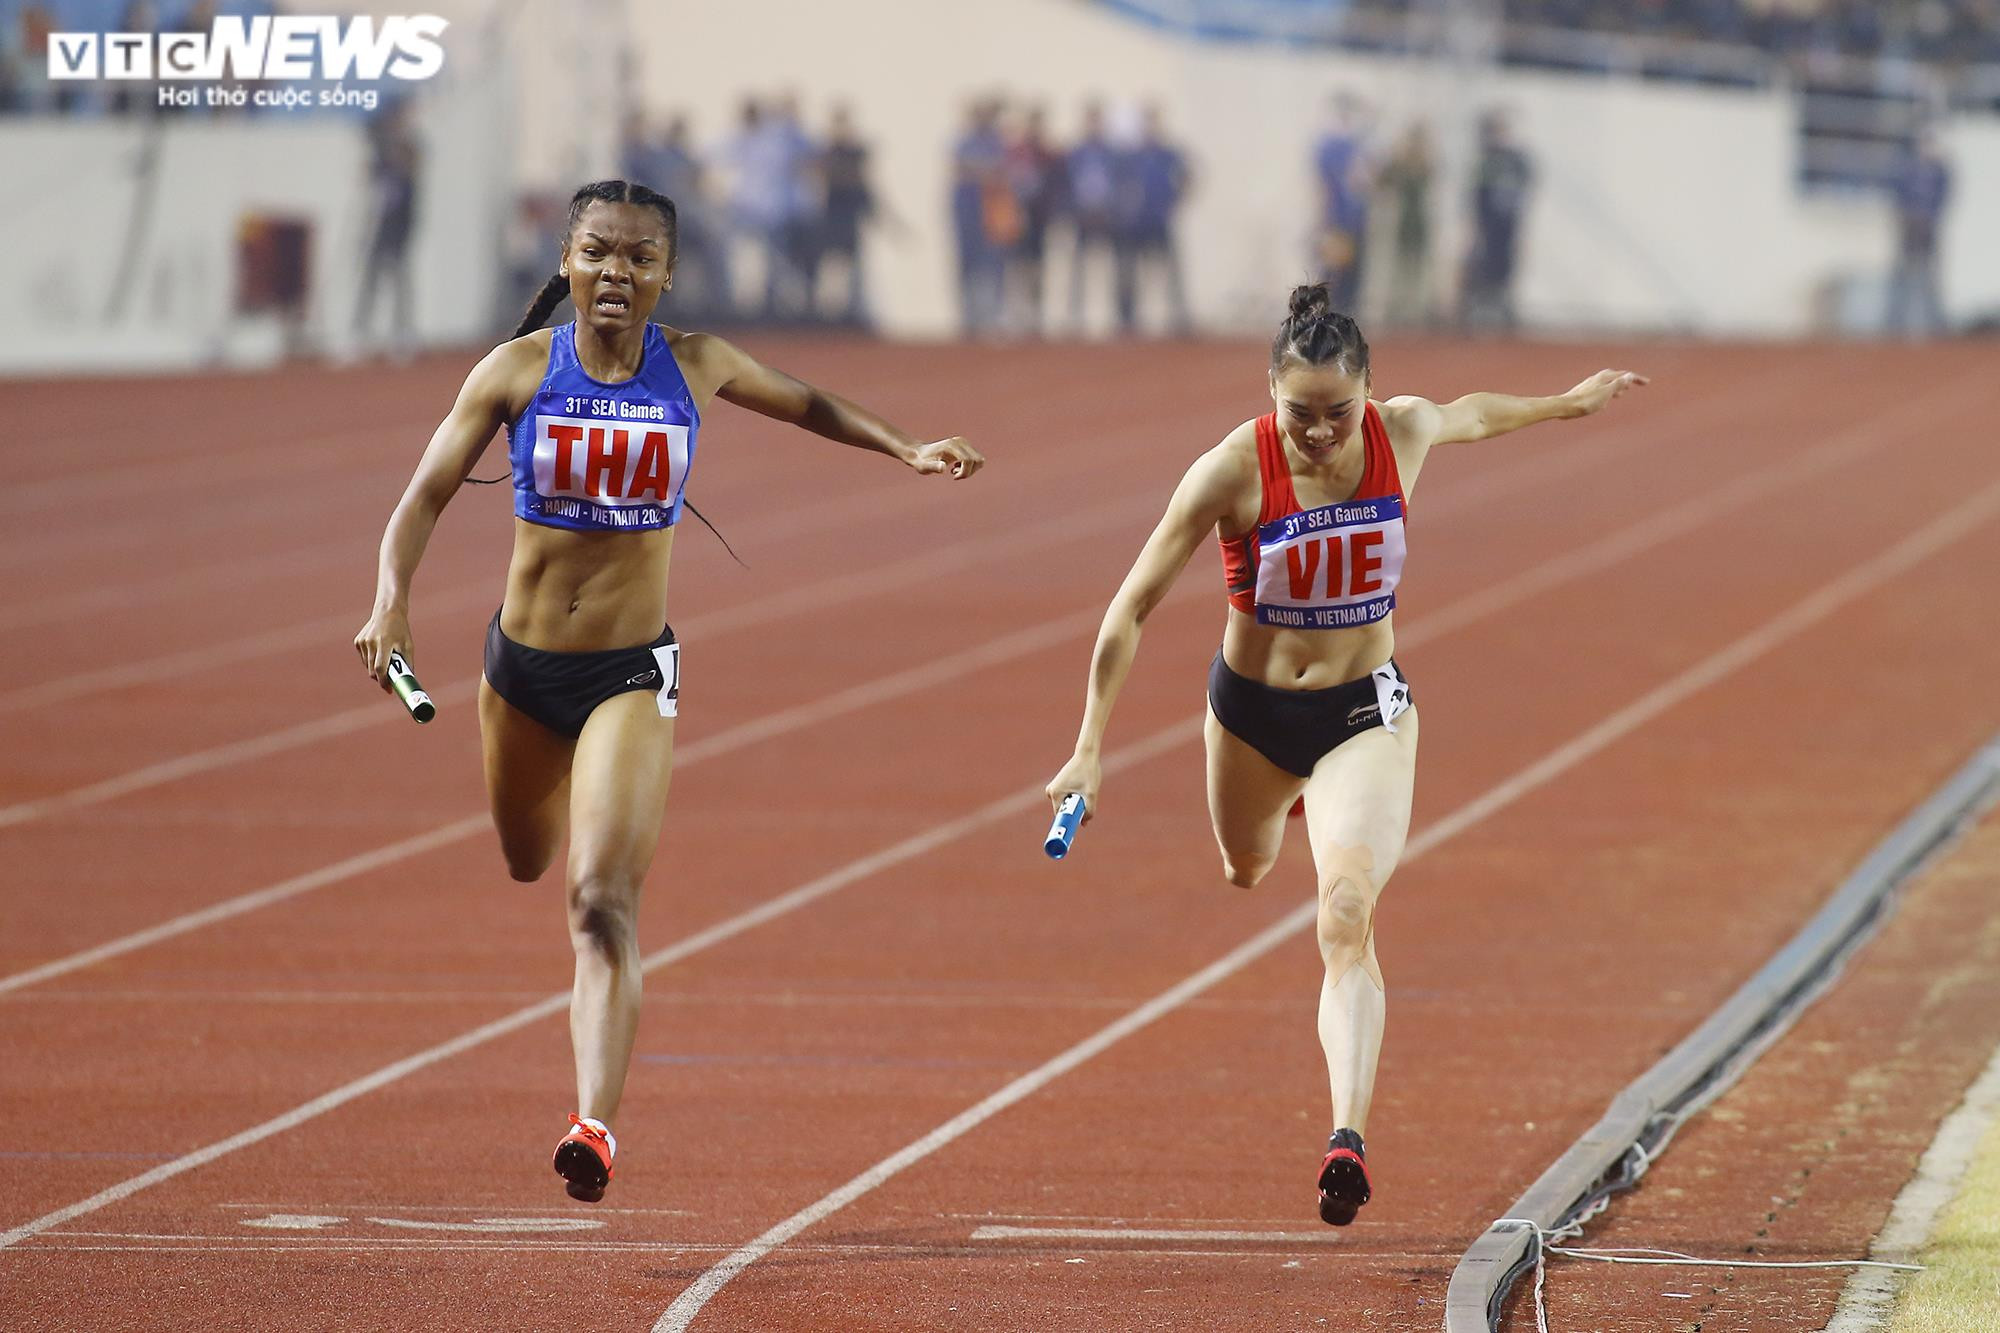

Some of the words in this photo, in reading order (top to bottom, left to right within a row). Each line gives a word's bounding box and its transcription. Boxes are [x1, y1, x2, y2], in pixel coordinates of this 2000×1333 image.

[592, 399, 617, 417] SEA
[620, 401, 664, 420] Games
[547, 424, 670, 501] THA
[544, 500, 580, 519] HANOI
[592, 506, 639, 526] VIETNAM
[1308, 511, 1332, 528] SEA
[1335, 505, 1378, 522] Games
[1286, 530, 1384, 600] VIE
[1267, 608, 1304, 625] HANOI
[1315, 607, 1367, 625] VIETNAM
[1347, 710, 1379, 726] LI-NIN
